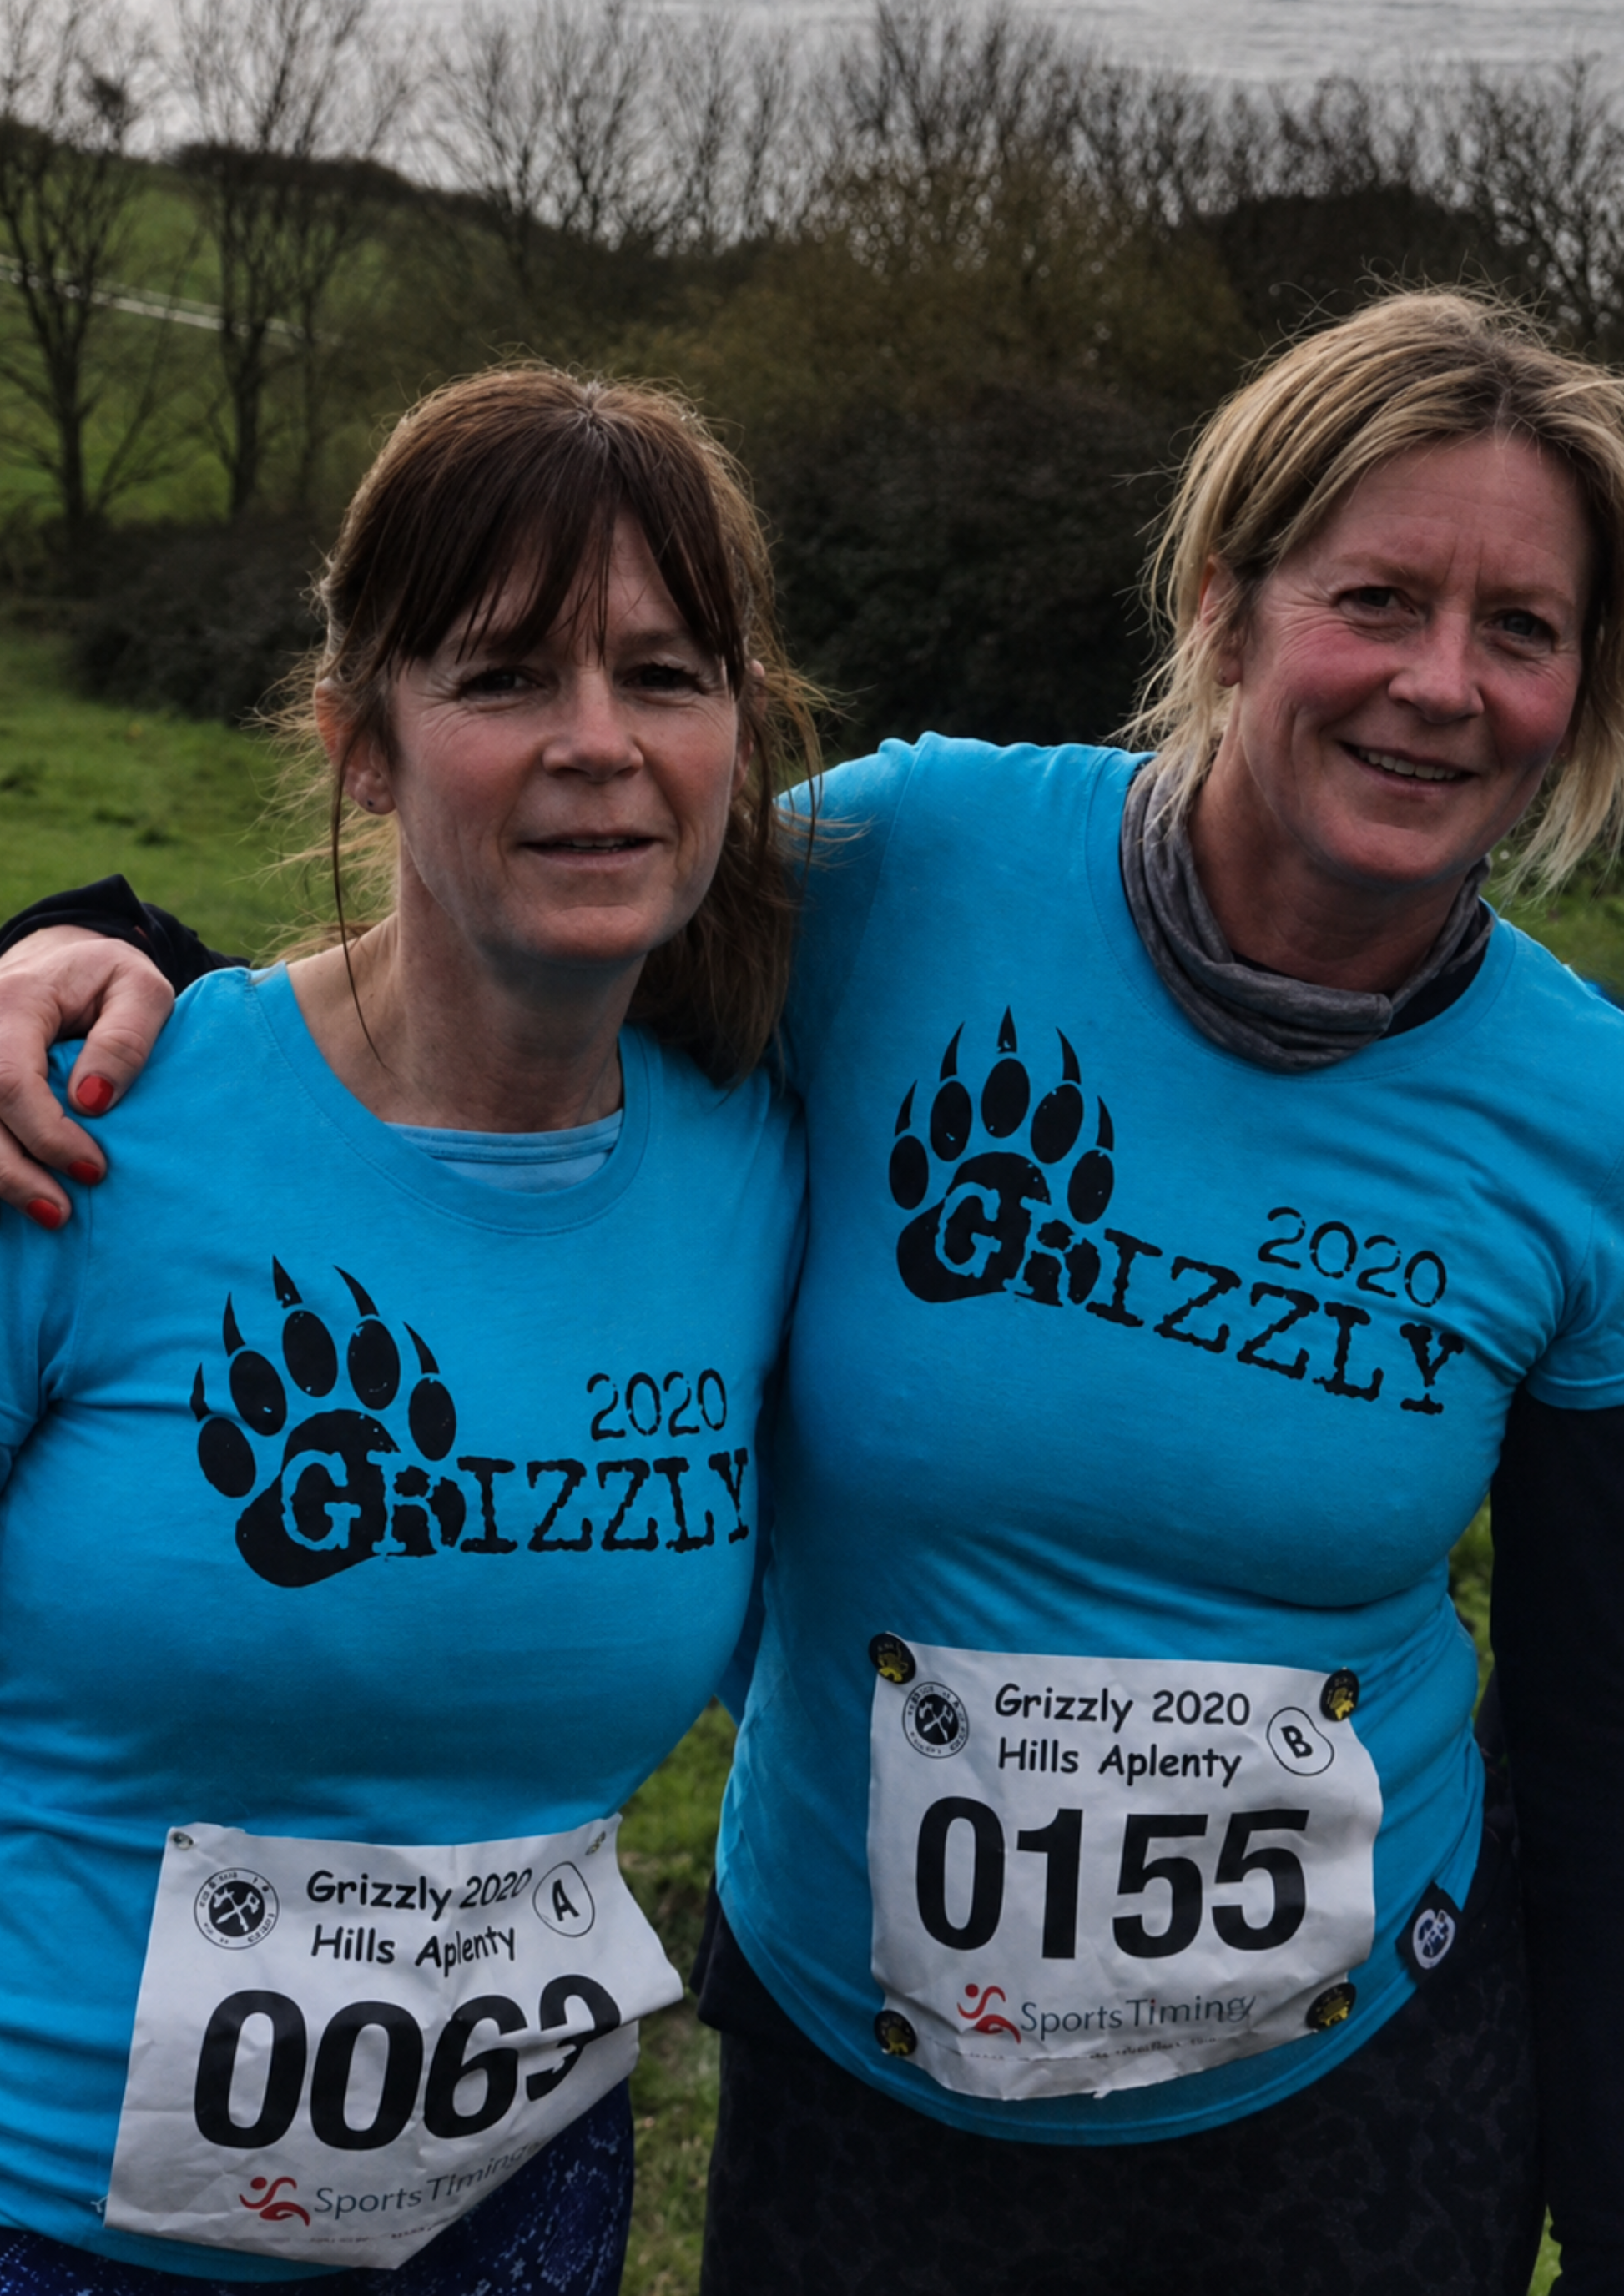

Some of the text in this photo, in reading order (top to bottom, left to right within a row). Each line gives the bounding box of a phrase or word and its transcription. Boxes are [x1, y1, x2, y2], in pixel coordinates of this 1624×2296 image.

[1258, 1206, 1447, 1307] 2020
[935, 1180, 1465, 1416] GRIZZLY
[585, 1367, 728, 1442] 2020
[280, 1448, 750, 1558] GRIZZLY
[995, 1683, 1133, 1734] Grizzly
[1152, 1689, 1250, 1725] 2020
[997, 1737, 1242, 1788] Hills Aplenty
[1279, 1724, 1314, 1759] B
[306, 1869, 453, 1921] Grizzly
[459, 1867, 534, 1909] 2020
[551, 1878, 581, 1921] A
[915, 1795, 1310, 1960] 0155
[310, 1923, 515, 1978] Hills Aplenty
